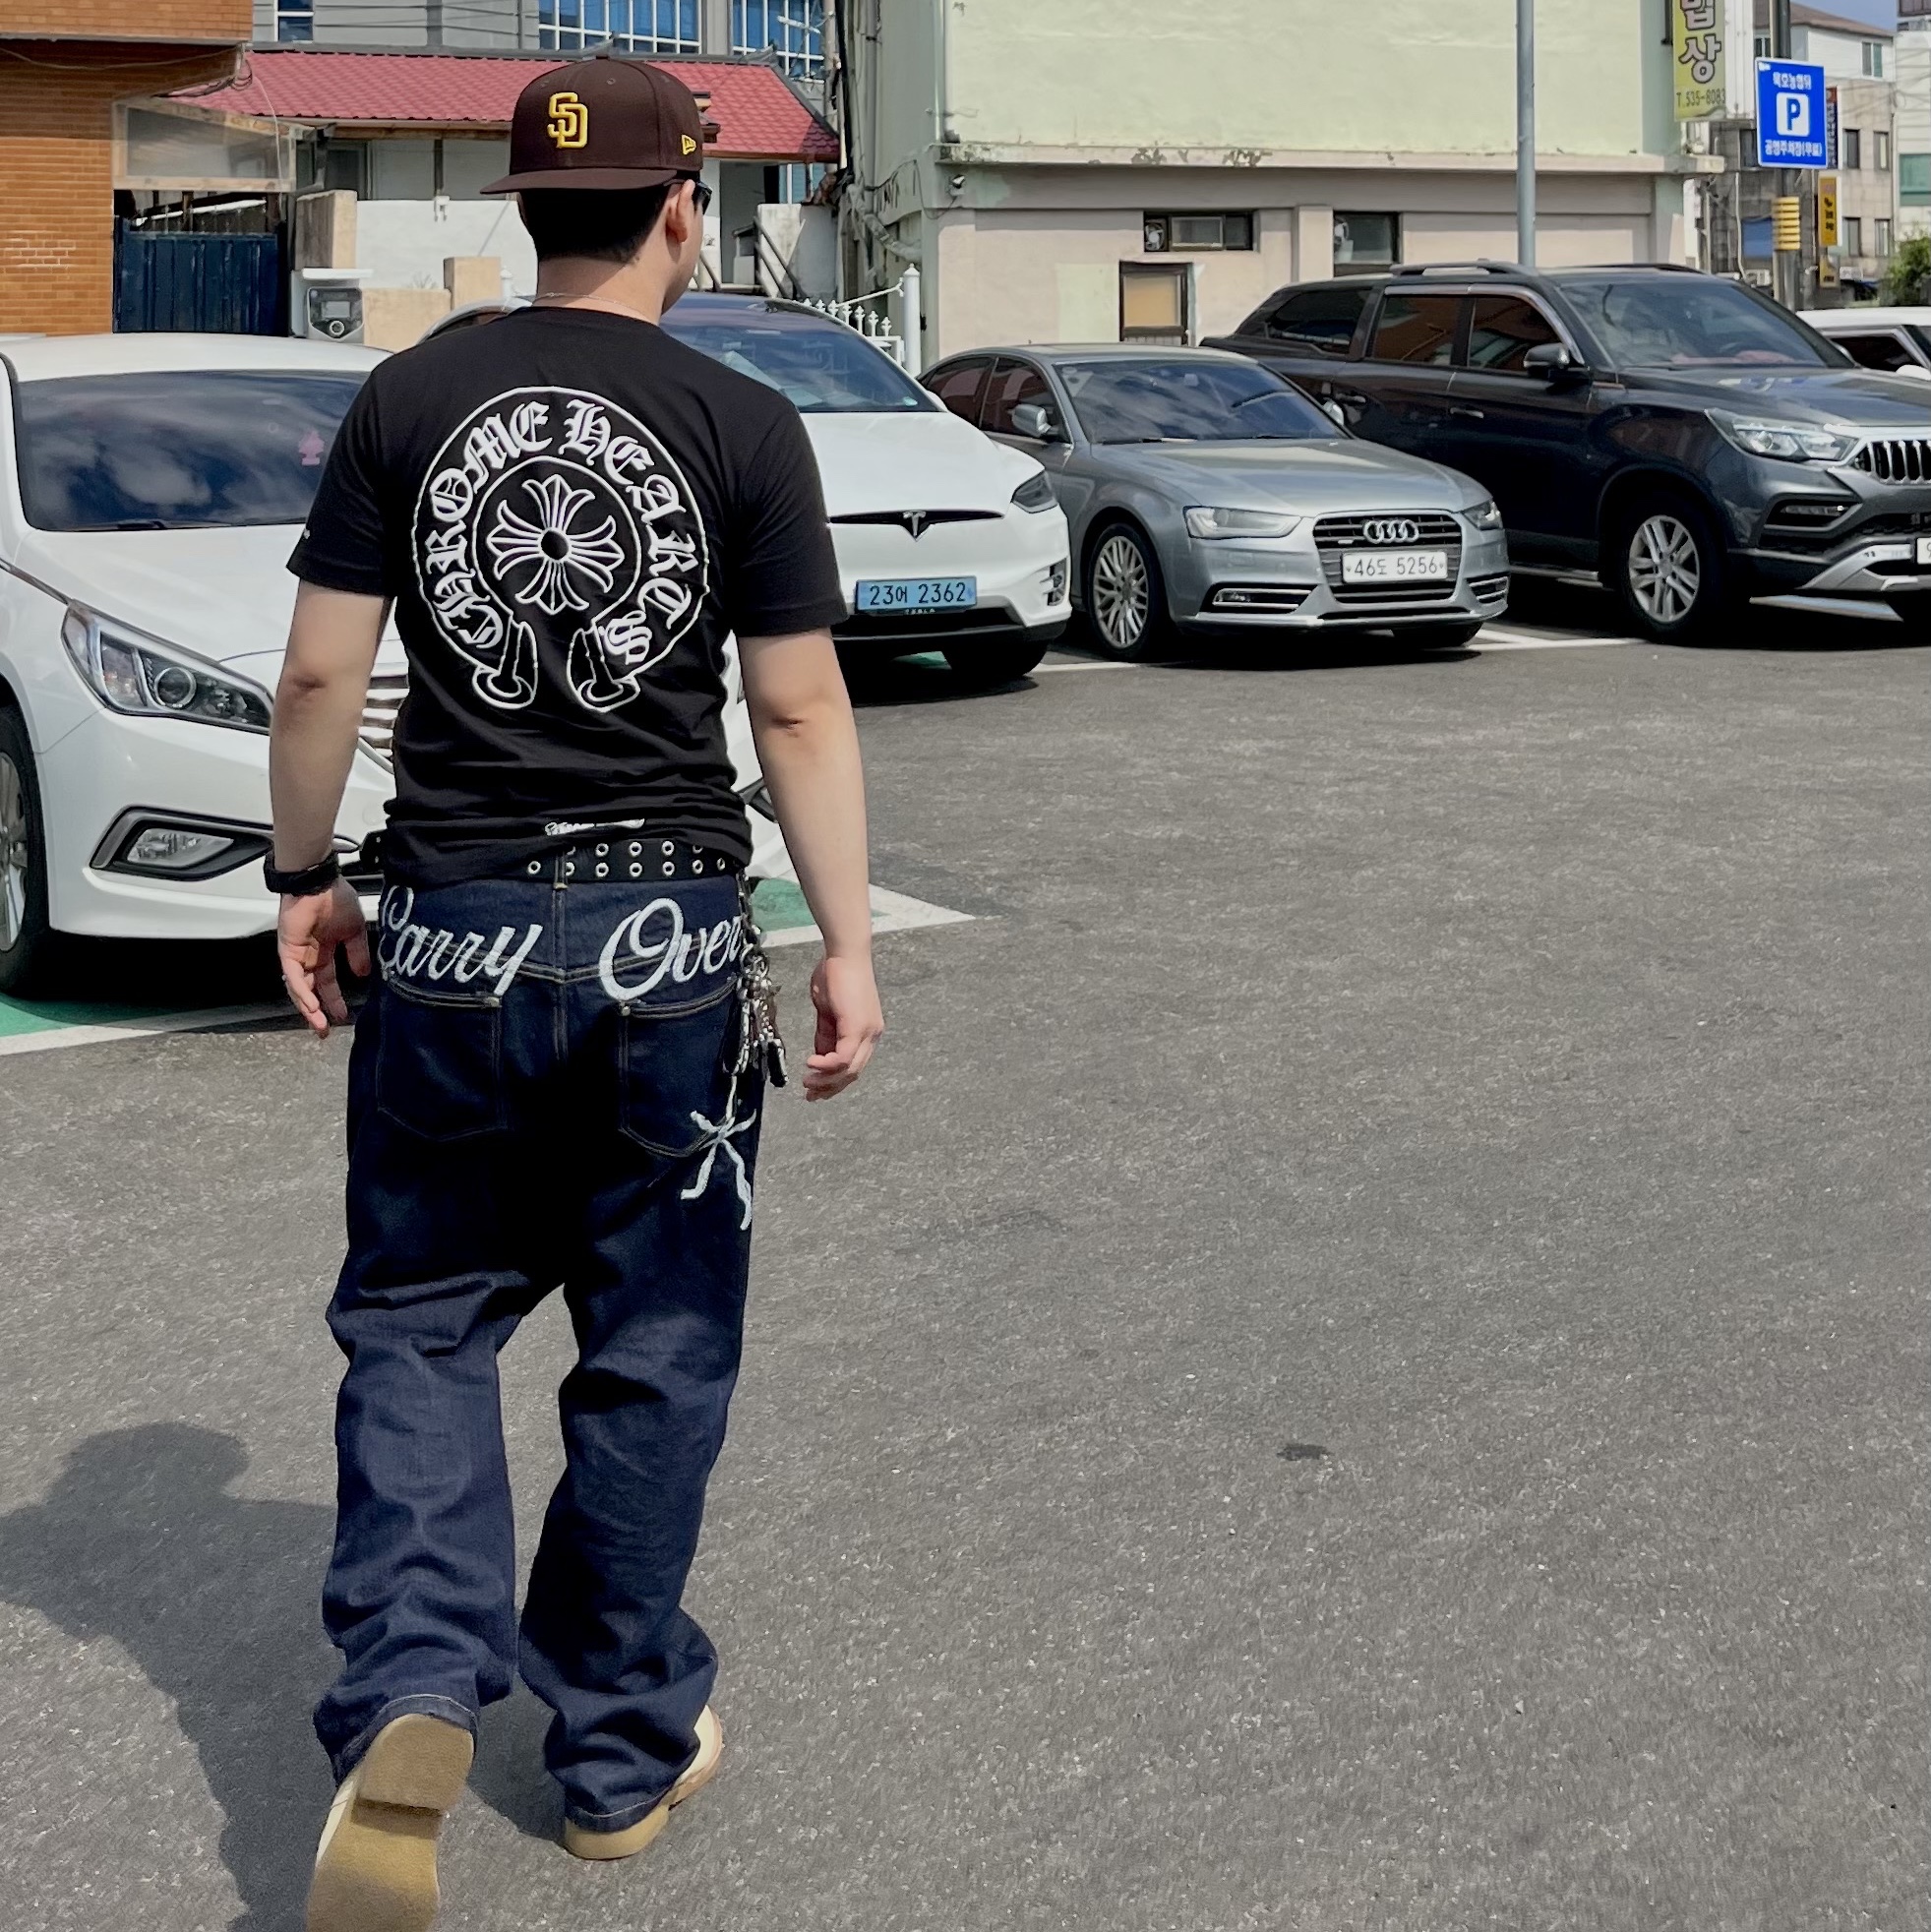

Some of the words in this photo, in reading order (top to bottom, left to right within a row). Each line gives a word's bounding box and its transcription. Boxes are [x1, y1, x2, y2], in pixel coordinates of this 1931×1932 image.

[547, 91, 588, 149] SD
[1786, 97, 1801, 131] P
[425, 400, 553, 649] CHROME
[558, 398, 699, 666] HEARTS
[1354, 558, 1387, 576] 46도
[1396, 556, 1438, 575] 5256
[869, 584, 908, 606] 23어
[918, 581, 966, 604] 2362
[599, 897, 744, 1001] Over
